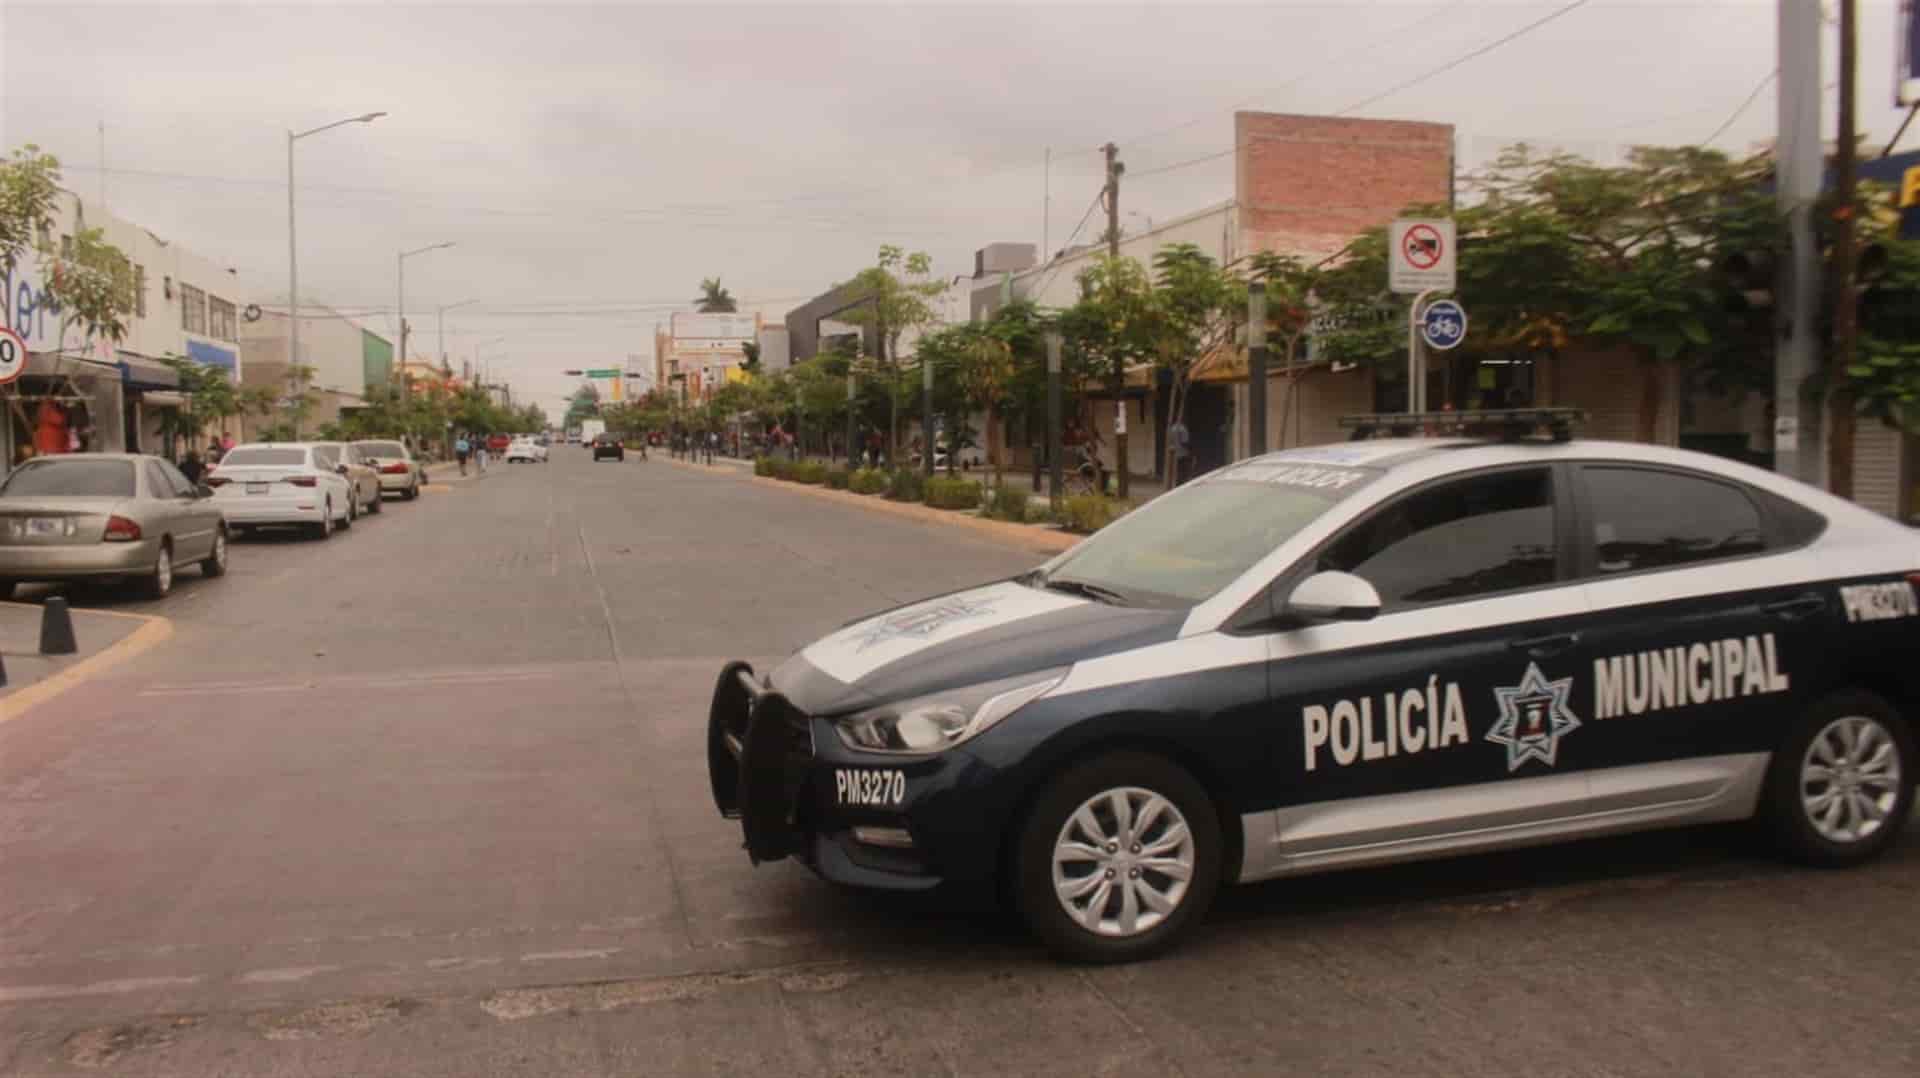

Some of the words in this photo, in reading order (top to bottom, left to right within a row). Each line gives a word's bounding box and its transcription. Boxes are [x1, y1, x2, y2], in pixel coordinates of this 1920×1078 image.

[1303, 673, 1469, 771] POLICÍA
[1594, 633, 1789, 719] MUNICIPAL
[835, 769, 905, 805] PM3270
